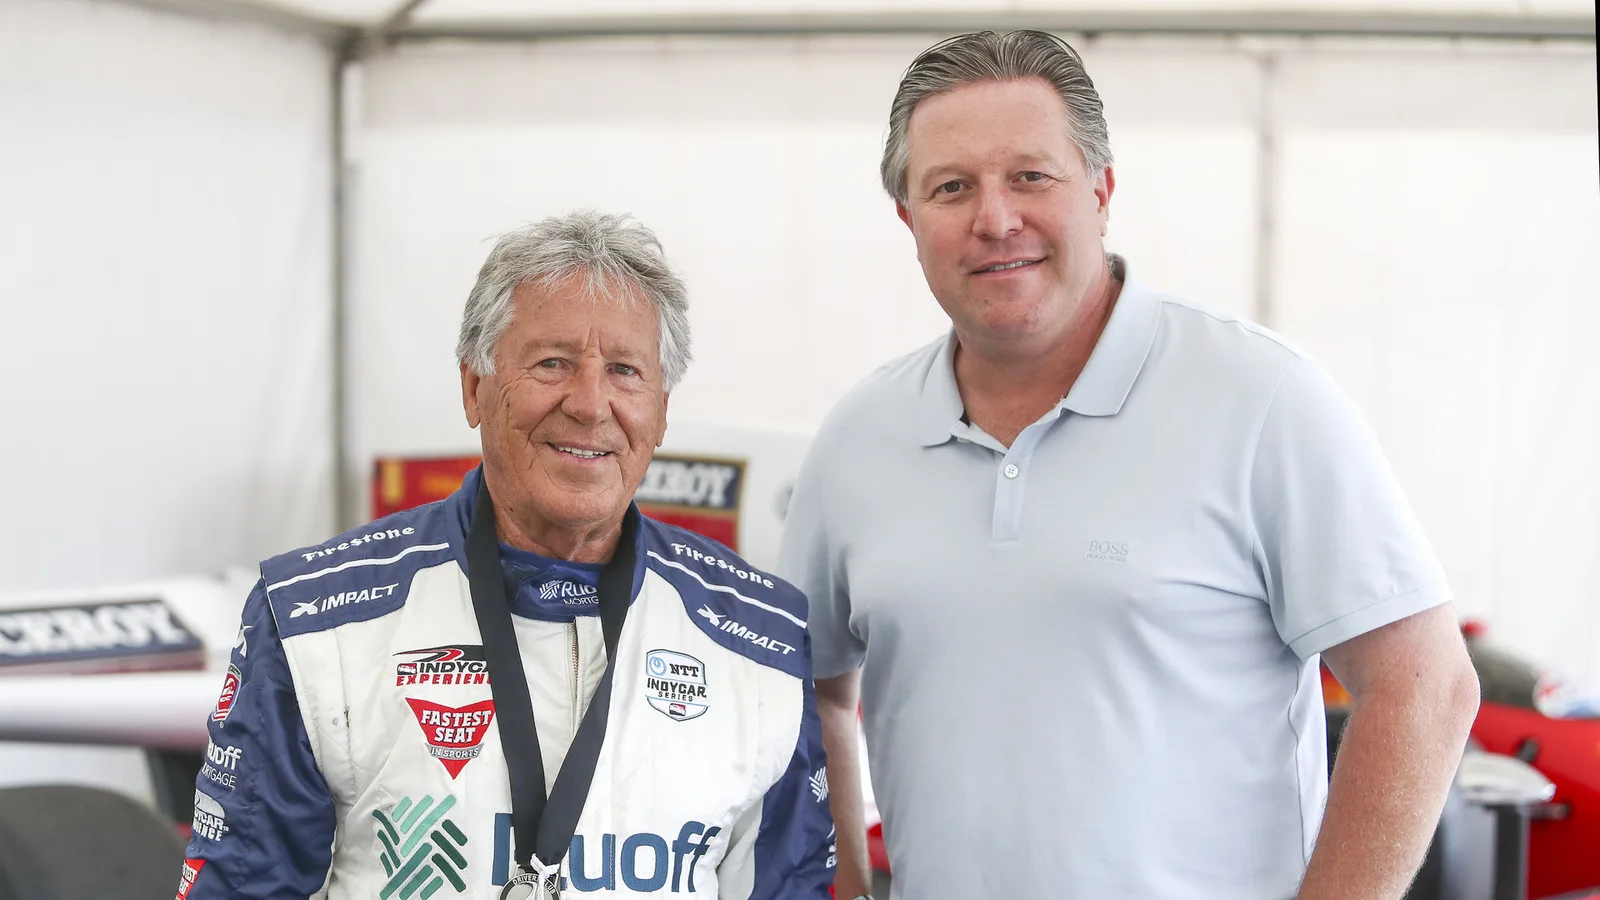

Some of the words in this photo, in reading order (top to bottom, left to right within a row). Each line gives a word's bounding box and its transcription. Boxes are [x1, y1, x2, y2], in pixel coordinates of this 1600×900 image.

[301, 526, 415, 563] Firestone
[1088, 540, 1129, 556] BOSS
[671, 542, 775, 589] Firestone
[320, 583, 399, 612] IMPACT
[561, 581, 598, 597] Ruo
[563, 596, 599, 605] MORTG
[719, 620, 796, 655] IMPACT
[419, 661, 488, 674] INDYC
[669, 663, 699, 677] NTT
[396, 673, 491, 687] EXPERIEN
[646, 677, 707, 699] INDYCAR
[658, 691, 694, 702] SERIES
[420, 709, 492, 727] FASTEST
[433, 727, 477, 744] SEAT
[206, 739, 243, 770] uoff
[443, 748, 479, 758] SPORTS
[512, 874, 540, 885] DRIVER
[544, 880, 556, 895] LUB
